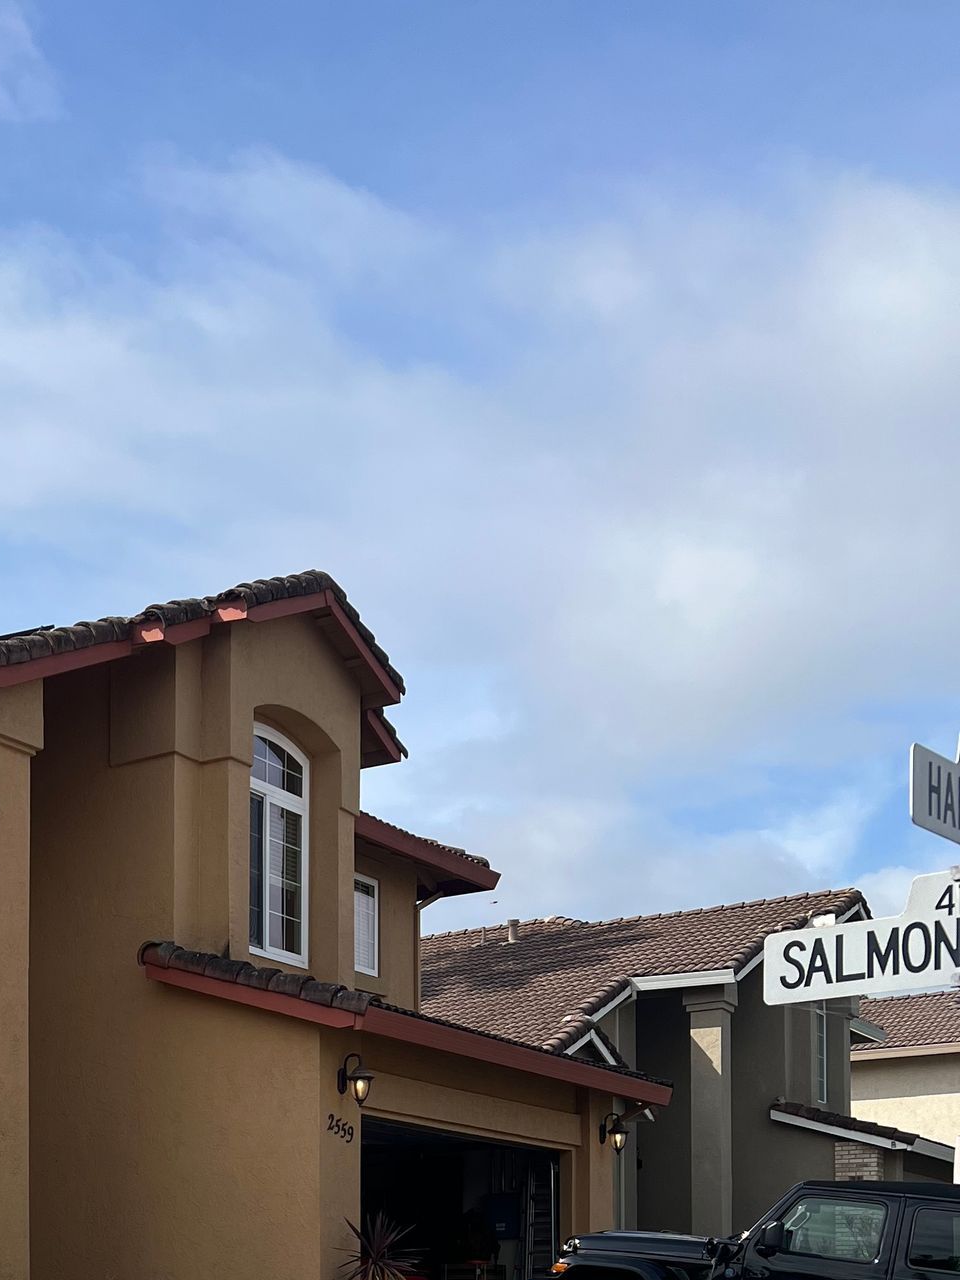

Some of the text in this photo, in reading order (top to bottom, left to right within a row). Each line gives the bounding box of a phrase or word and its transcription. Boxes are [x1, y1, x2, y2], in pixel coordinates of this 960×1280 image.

[928, 761, 960, 831] HA
[935, 884, 960, 916] 4
[780, 917, 960, 989] SALMON
[327, 1113, 354, 1143] 2559
